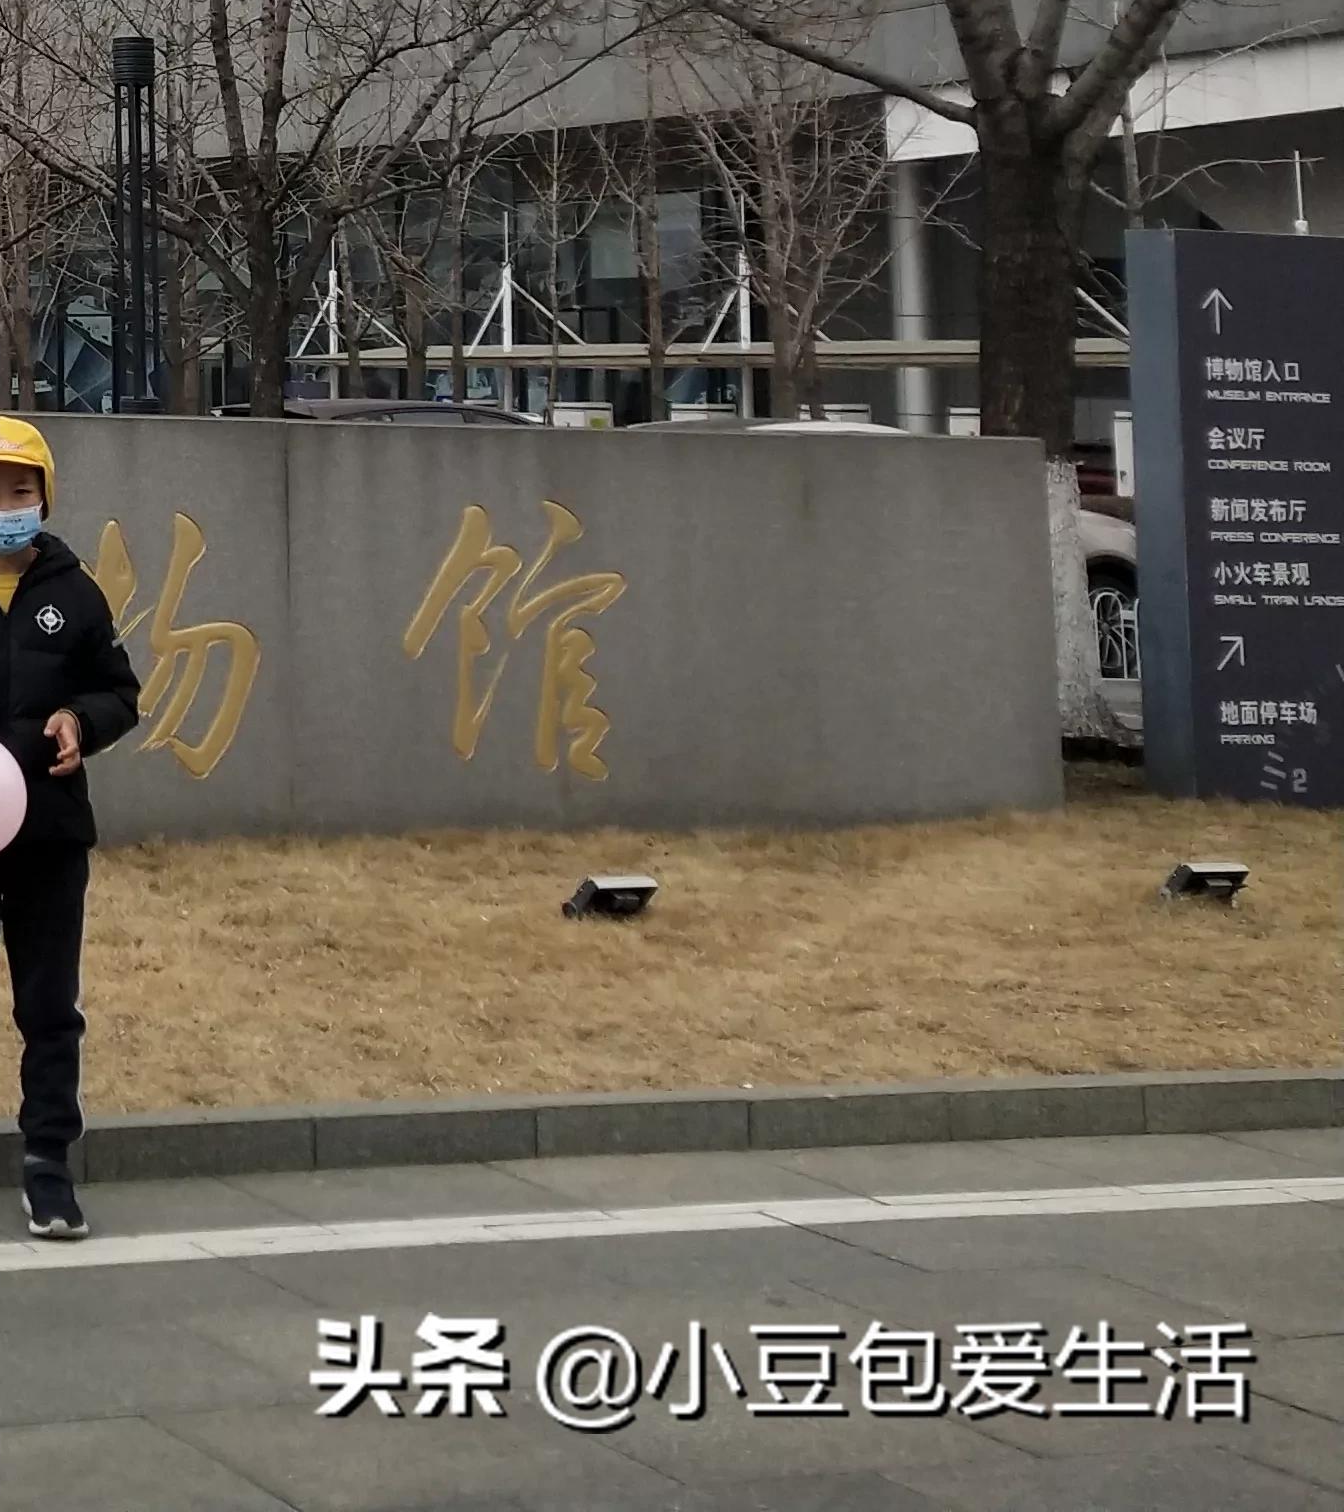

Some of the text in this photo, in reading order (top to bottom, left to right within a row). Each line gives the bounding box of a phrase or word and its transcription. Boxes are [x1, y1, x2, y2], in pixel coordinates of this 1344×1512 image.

[1206, 356, 1300, 383] 博物馆入口
[1207, 389, 1331, 403] MUSEUM ENTRANCE
[1208, 426, 1265, 451] 会议厅
[1207, 459, 1331, 472] CONFERENCE ROOM
[1211, 497, 1307, 522] 新闻发布厅
[1210, 531, 1341, 544] PRESS CONFERENCE
[1214, 561, 1311, 586] 小火车景观
[1213, 594, 1257, 605] SMALL
[1261, 594, 1300, 606] TRAIN
[1220, 700, 1317, 726] 地面停车场
[1220, 734, 1275, 745] PARKING
